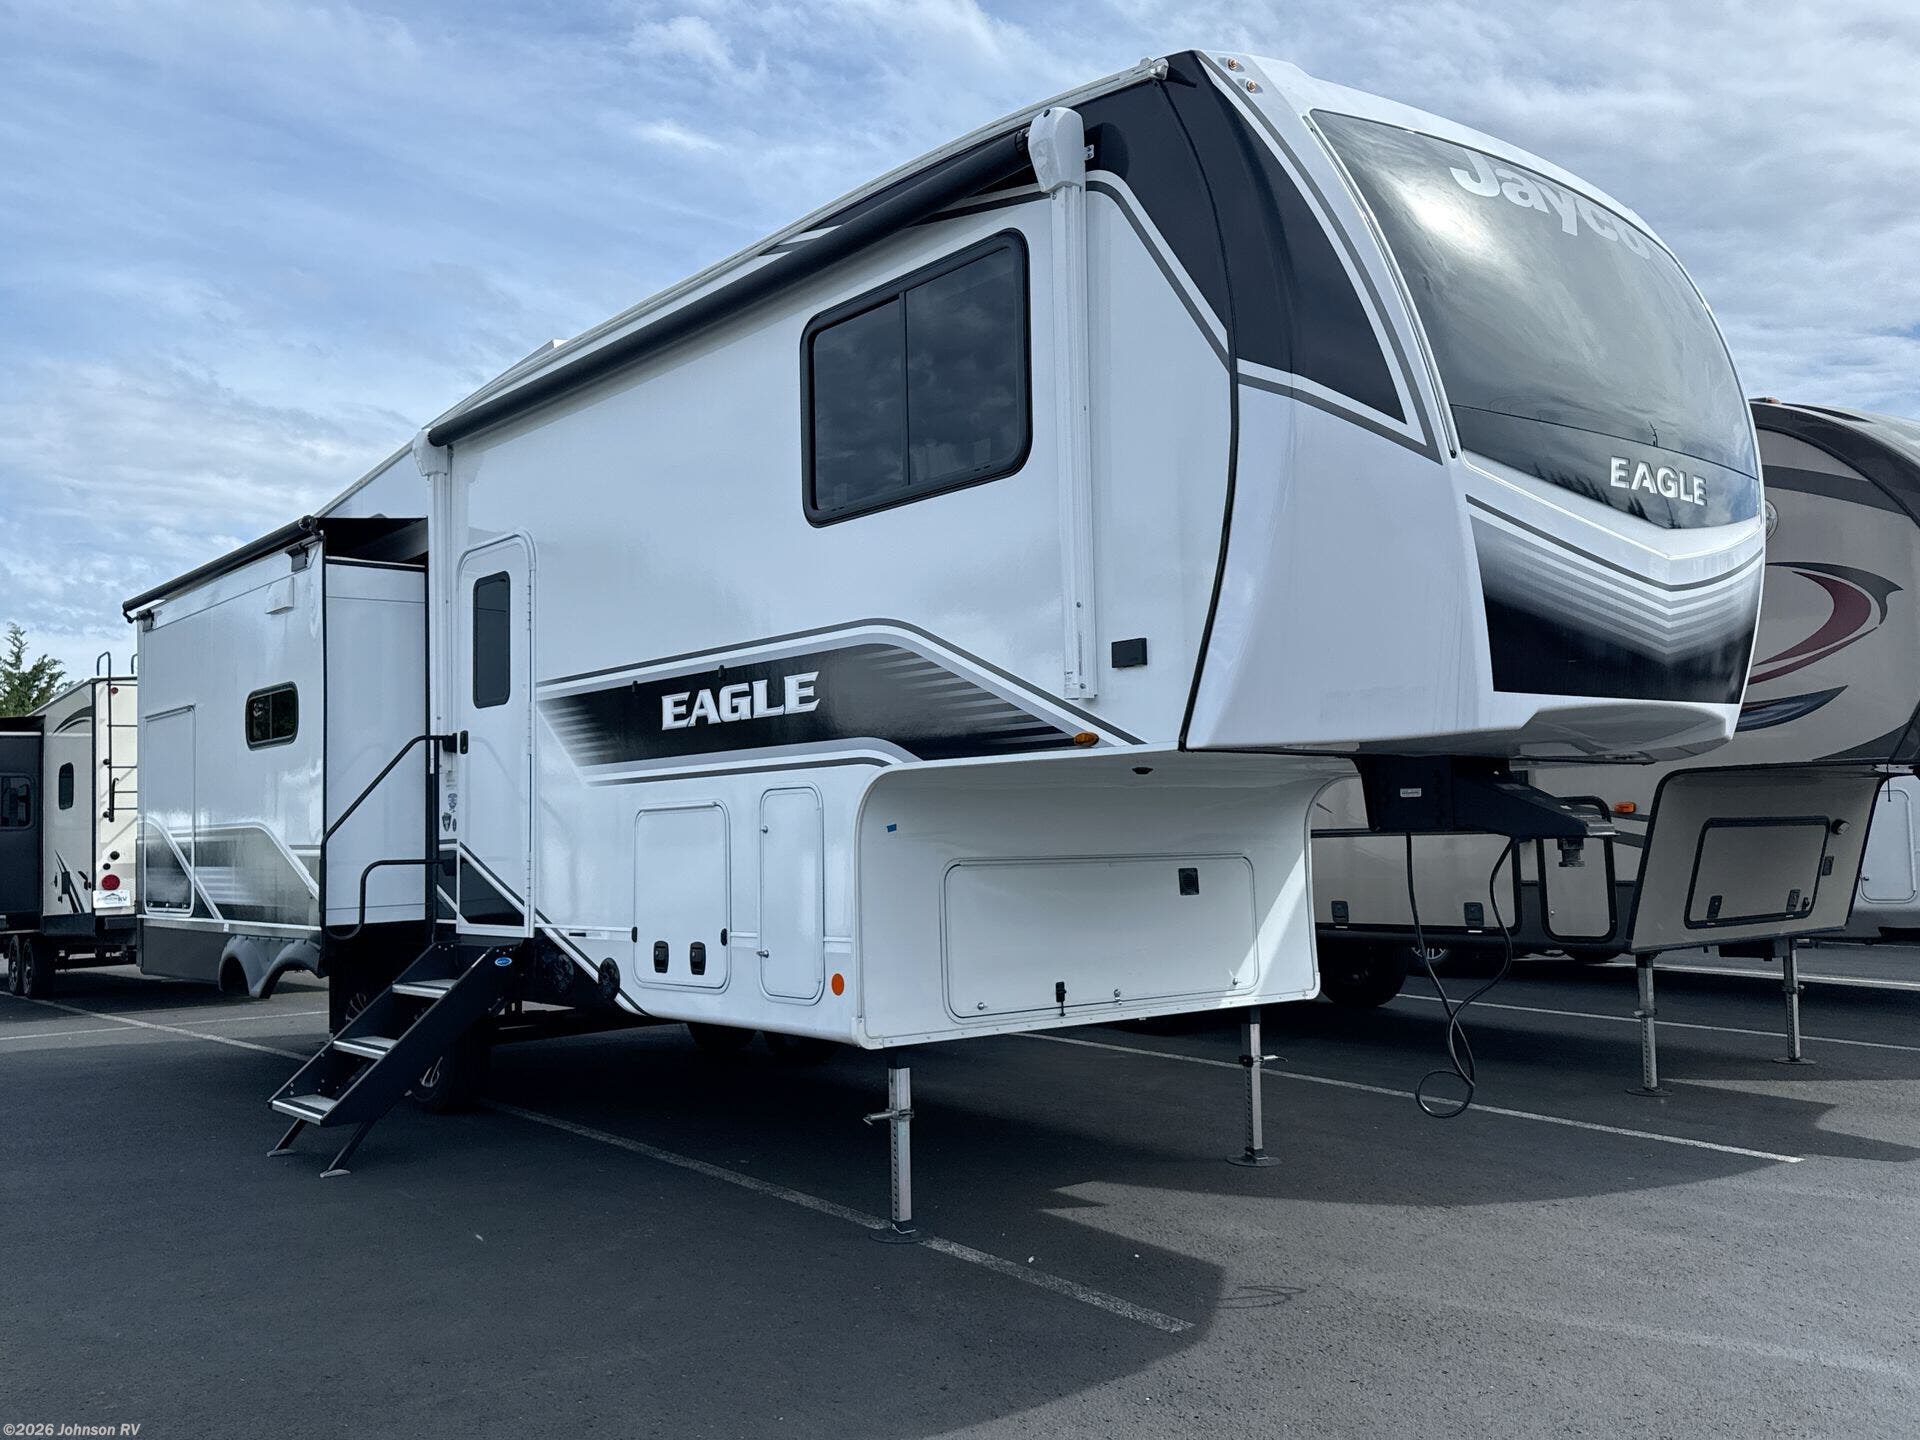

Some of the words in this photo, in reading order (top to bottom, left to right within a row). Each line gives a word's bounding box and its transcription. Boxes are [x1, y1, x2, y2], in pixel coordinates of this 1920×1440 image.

[1450, 149, 1650, 259] Jayco
[1610, 456, 1707, 506] EAGLE
[661, 671, 820, 731] EAGLE
